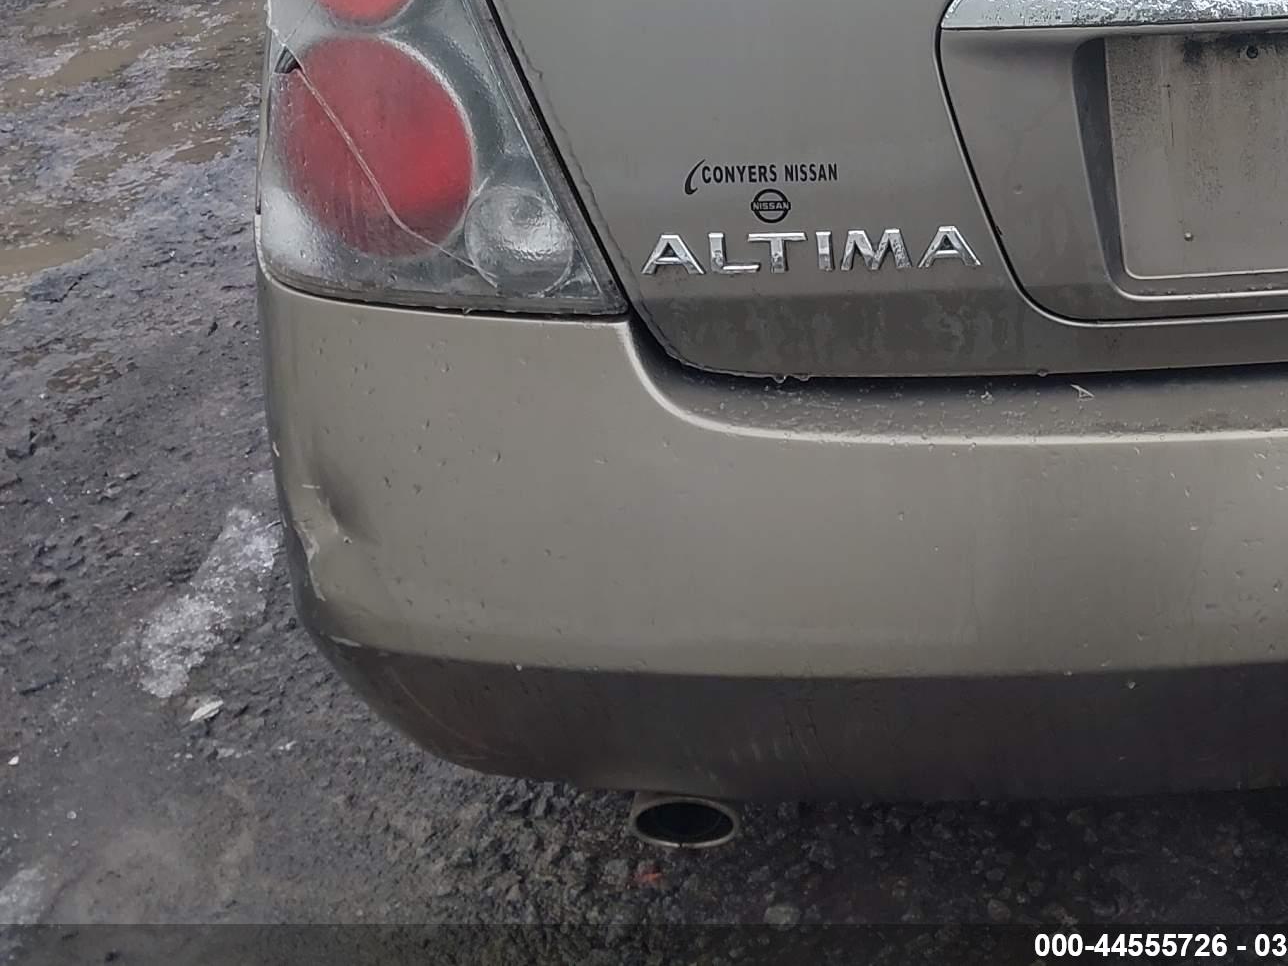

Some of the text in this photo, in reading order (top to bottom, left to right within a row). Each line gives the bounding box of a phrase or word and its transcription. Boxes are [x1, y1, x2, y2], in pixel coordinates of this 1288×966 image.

[702, 163, 838, 184] CONYERS NISSAN
[752, 201, 790, 211] NISSAN
[641, 224, 982, 275] ALTIMA
